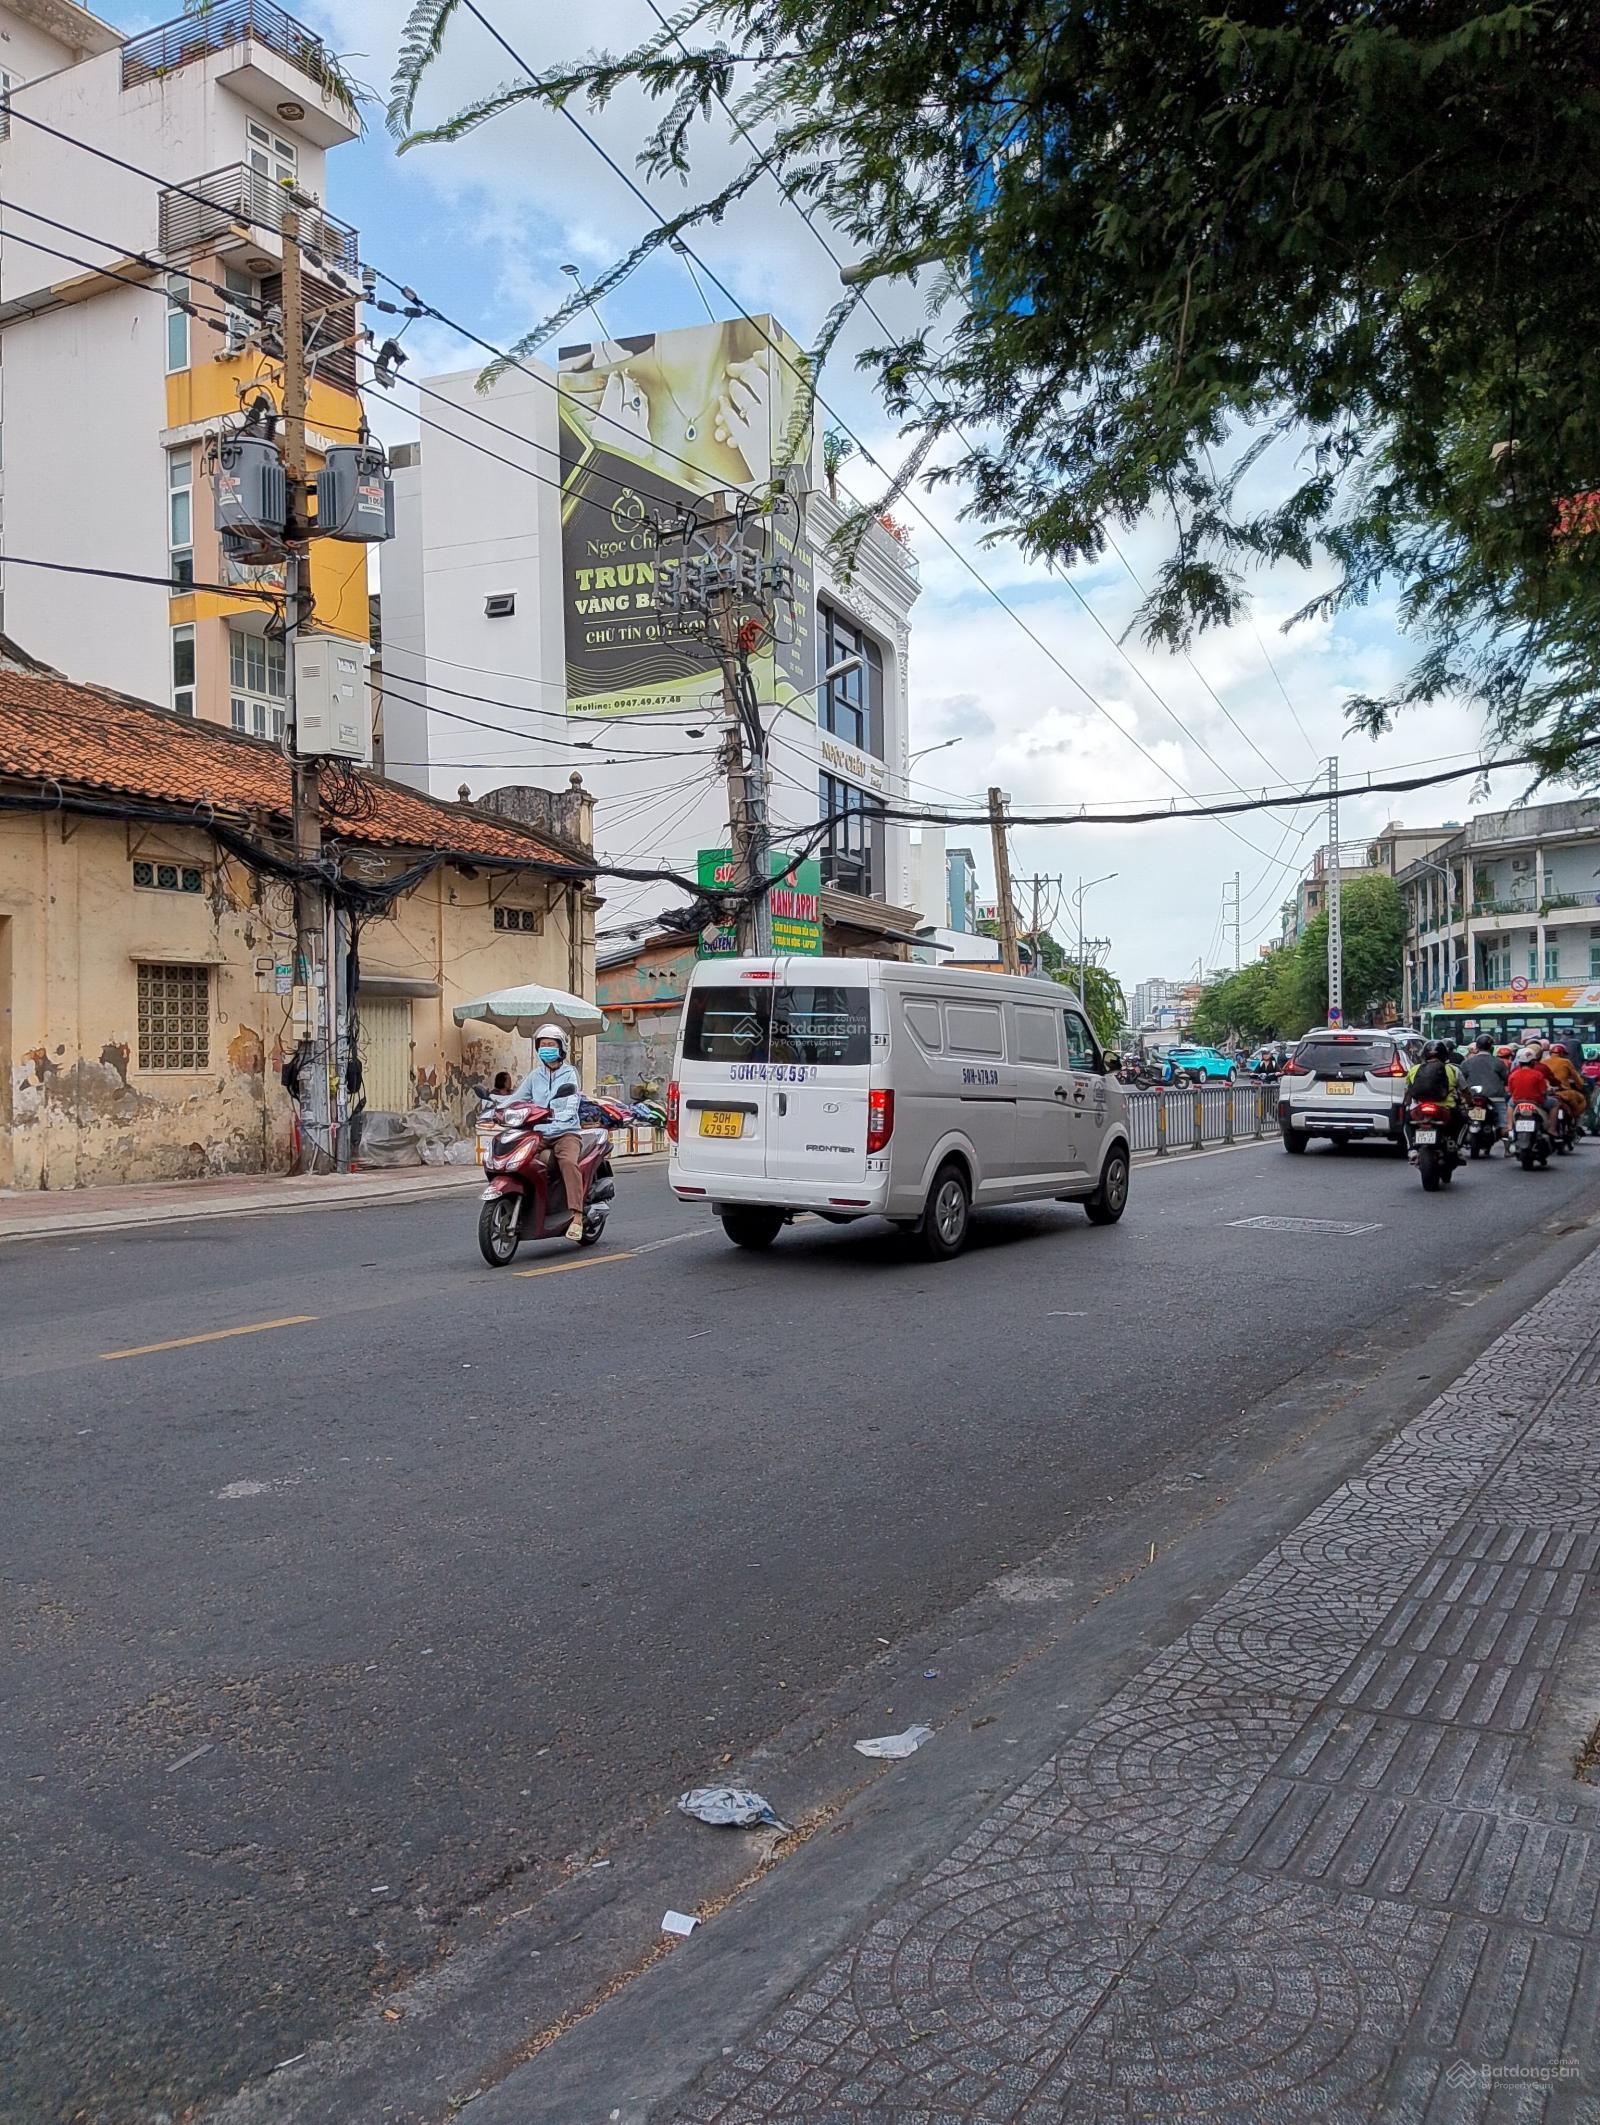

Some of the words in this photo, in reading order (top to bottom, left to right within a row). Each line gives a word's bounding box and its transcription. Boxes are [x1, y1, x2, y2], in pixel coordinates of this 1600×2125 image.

[586, 538, 627, 559] Ngọc
[575, 595, 629, 614] VÀNG
[618, 622, 641, 640] TÍN
[575, 703, 611, 712] Hotline:
[712, 1113, 731, 1124] 50H
[704, 1124, 737, 1136] 479.59
[806, 1144, 855, 1153] FRONTIER
